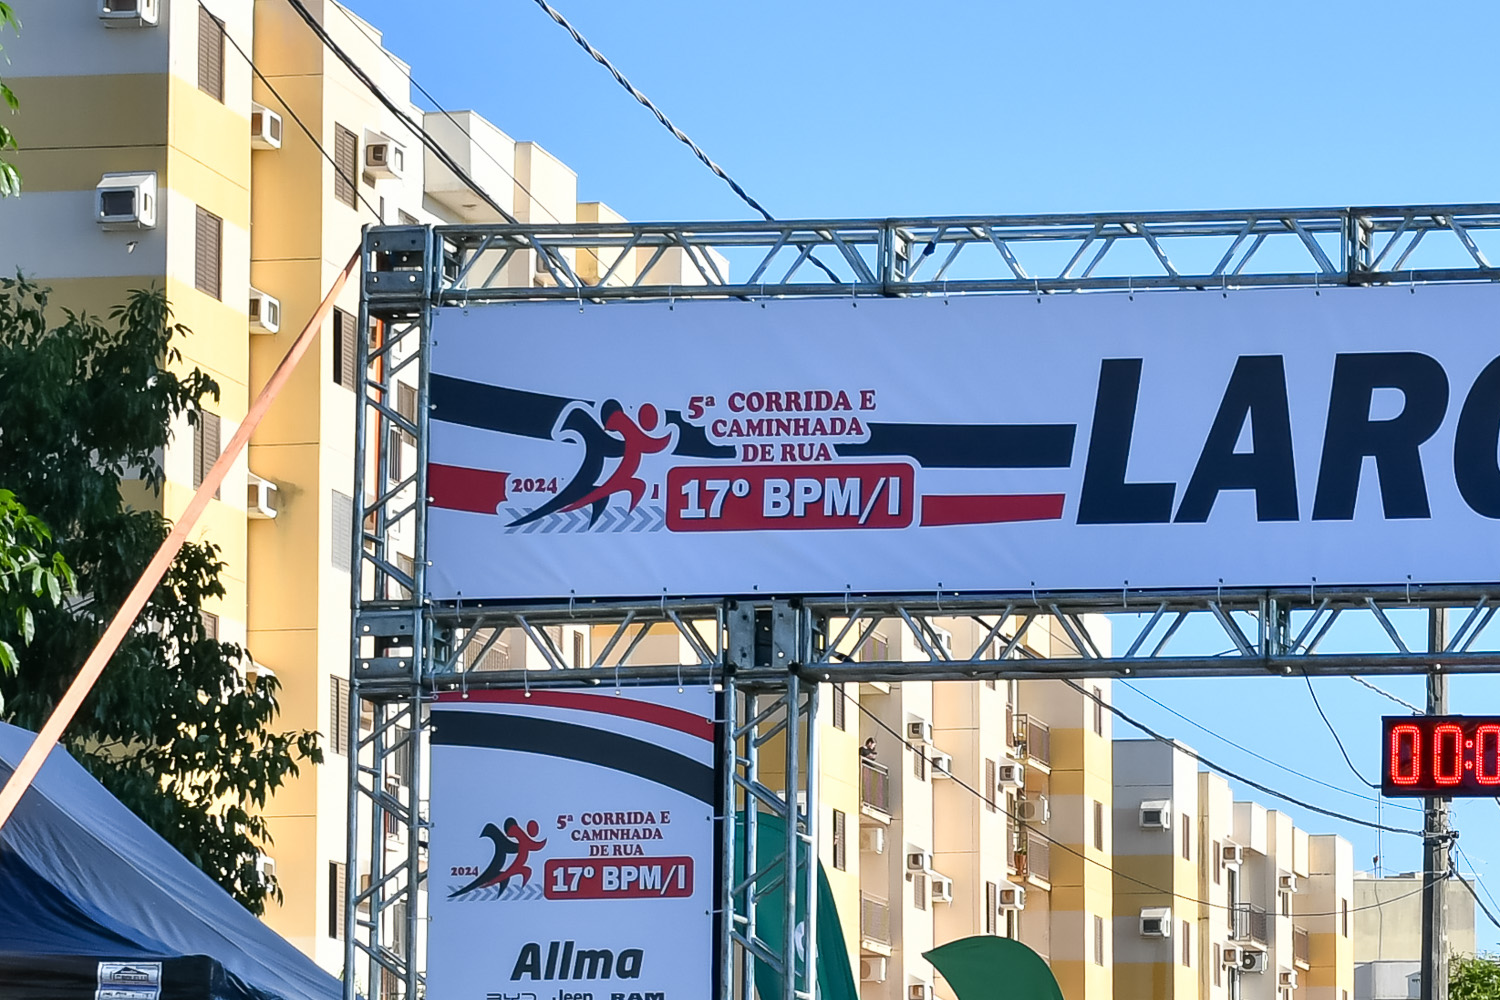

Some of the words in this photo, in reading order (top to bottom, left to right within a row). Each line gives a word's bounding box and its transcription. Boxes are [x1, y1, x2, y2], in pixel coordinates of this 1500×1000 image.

[688, 395, 716, 419] 5ª
[729, 391, 854, 414] CORRIDA
[859, 390, 876, 410] E
[711, 417, 864, 437] CAMINHADA
[741, 443, 775, 463] DE
[781, 441, 832, 462] RUA
[511, 477, 558, 494] 2024
[763, 474, 900, 525] BPM/I
[581, 812, 655, 826] CORRIDA
[660, 811, 671, 824] E
[571, 828, 663, 841] CAMINHADA
[589, 845, 610, 856] DE
[613, 844, 644, 856] RUA
[450, 866, 479, 877] 2024
[602, 864, 686, 895] BPM/I
[510, 941, 644, 981] Allma
